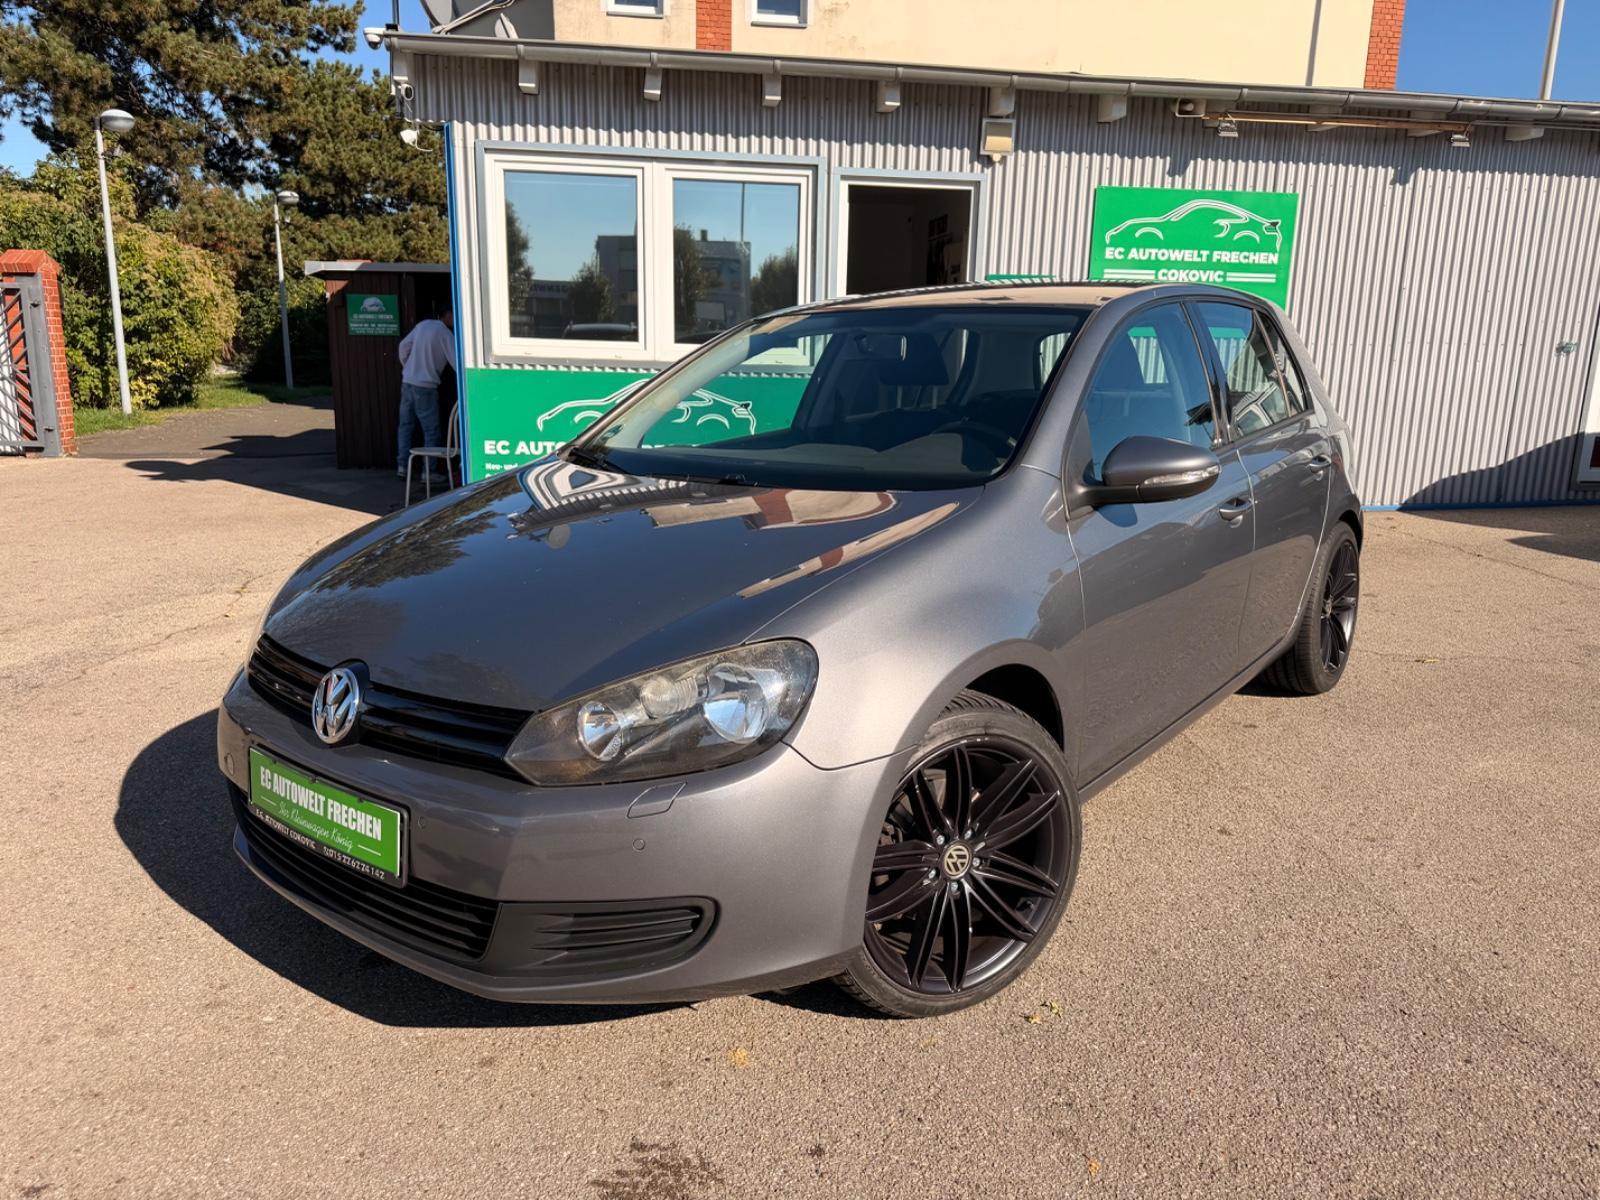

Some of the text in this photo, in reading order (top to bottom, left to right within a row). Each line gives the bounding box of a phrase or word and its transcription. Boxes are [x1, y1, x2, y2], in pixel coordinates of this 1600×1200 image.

[1104, 247, 1279, 265] EC AUTOWELT FRECHEN
[1158, 269, 1225, 283] COKOVIC
[484, 439, 510, 455] EC
[260, 765, 382, 842] EC AUTOWELT FRECHEN
